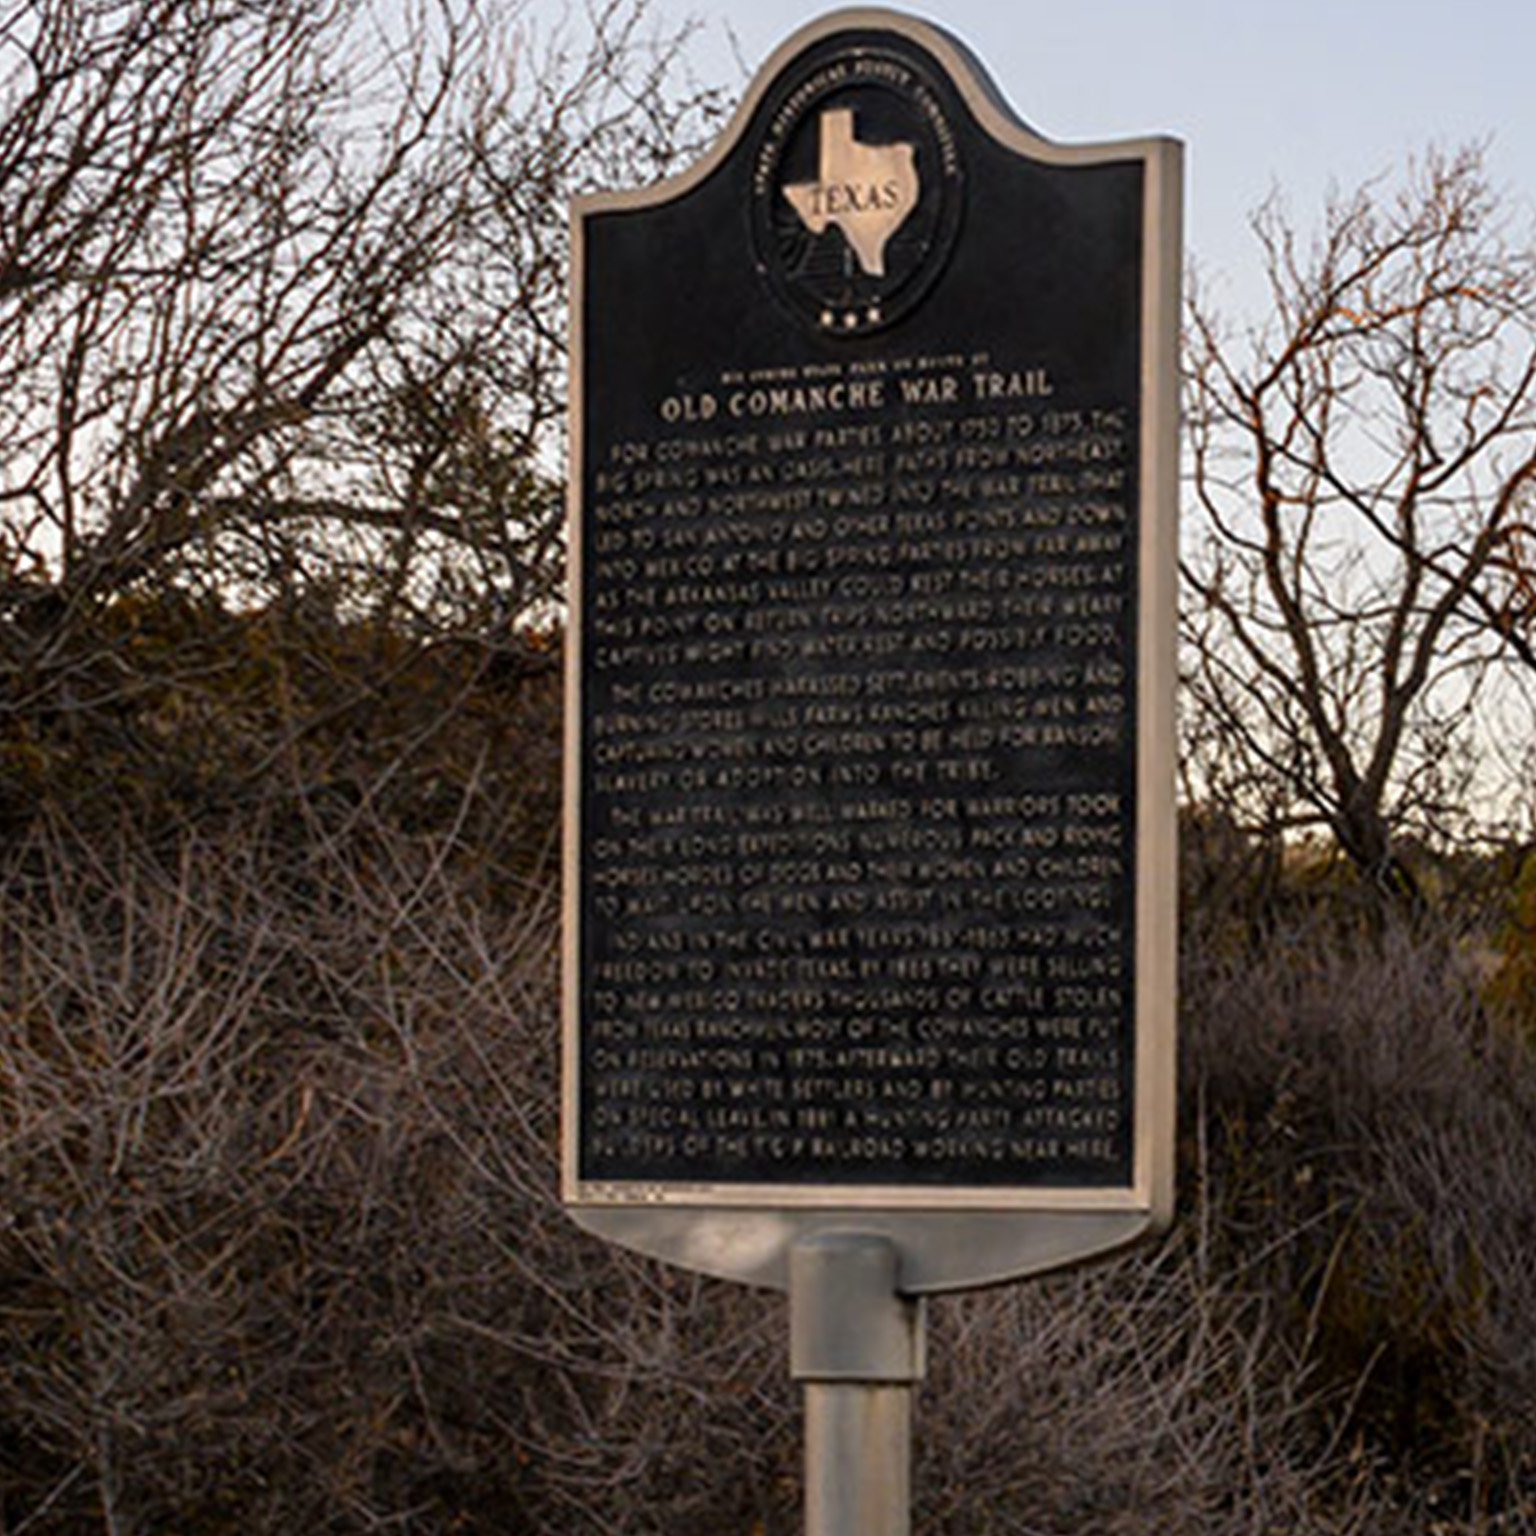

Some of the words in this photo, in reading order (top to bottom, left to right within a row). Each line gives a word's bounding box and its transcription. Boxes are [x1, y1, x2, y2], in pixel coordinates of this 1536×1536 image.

[809, 181, 900, 216] TEXAS
[661, 392, 716, 422] OLD
[729, 381, 883, 418] COMANCHE
[900, 375, 957, 406] WAR
[973, 369, 1053, 401] TRAIL
[1007, 415, 1033, 440] TO
[664, 495, 700, 519] AND
[631, 526, 653, 550] TO
[792, 516, 827, 542] AND
[704, 610, 733, 634] ON
